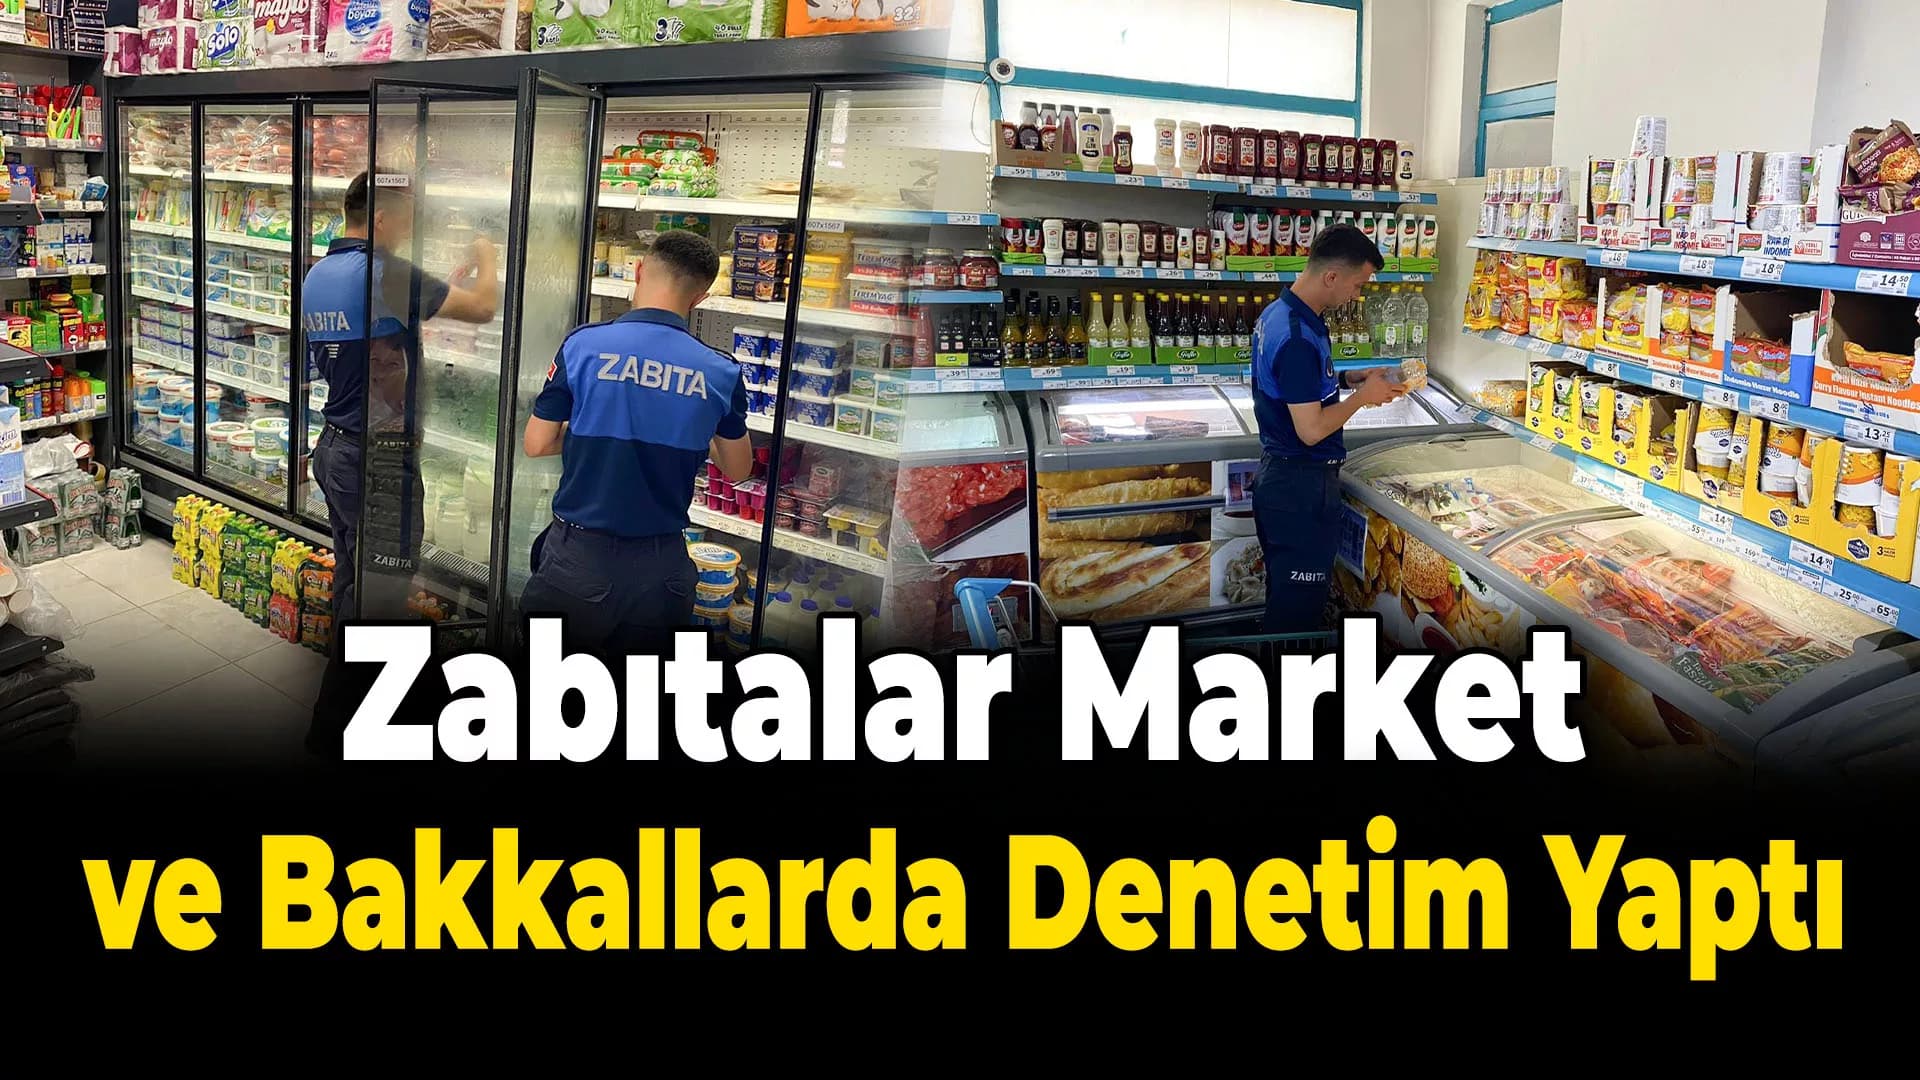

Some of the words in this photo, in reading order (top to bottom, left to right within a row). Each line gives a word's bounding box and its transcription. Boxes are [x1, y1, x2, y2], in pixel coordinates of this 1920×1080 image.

[656, 19, 668, 40] 3
[597, 353, 708, 400] ZABITA
[1832, 385, 1858, 397] Flavour
[1859, 390, 1886, 403] Instant
[374, 553, 412, 569] ZABITA
